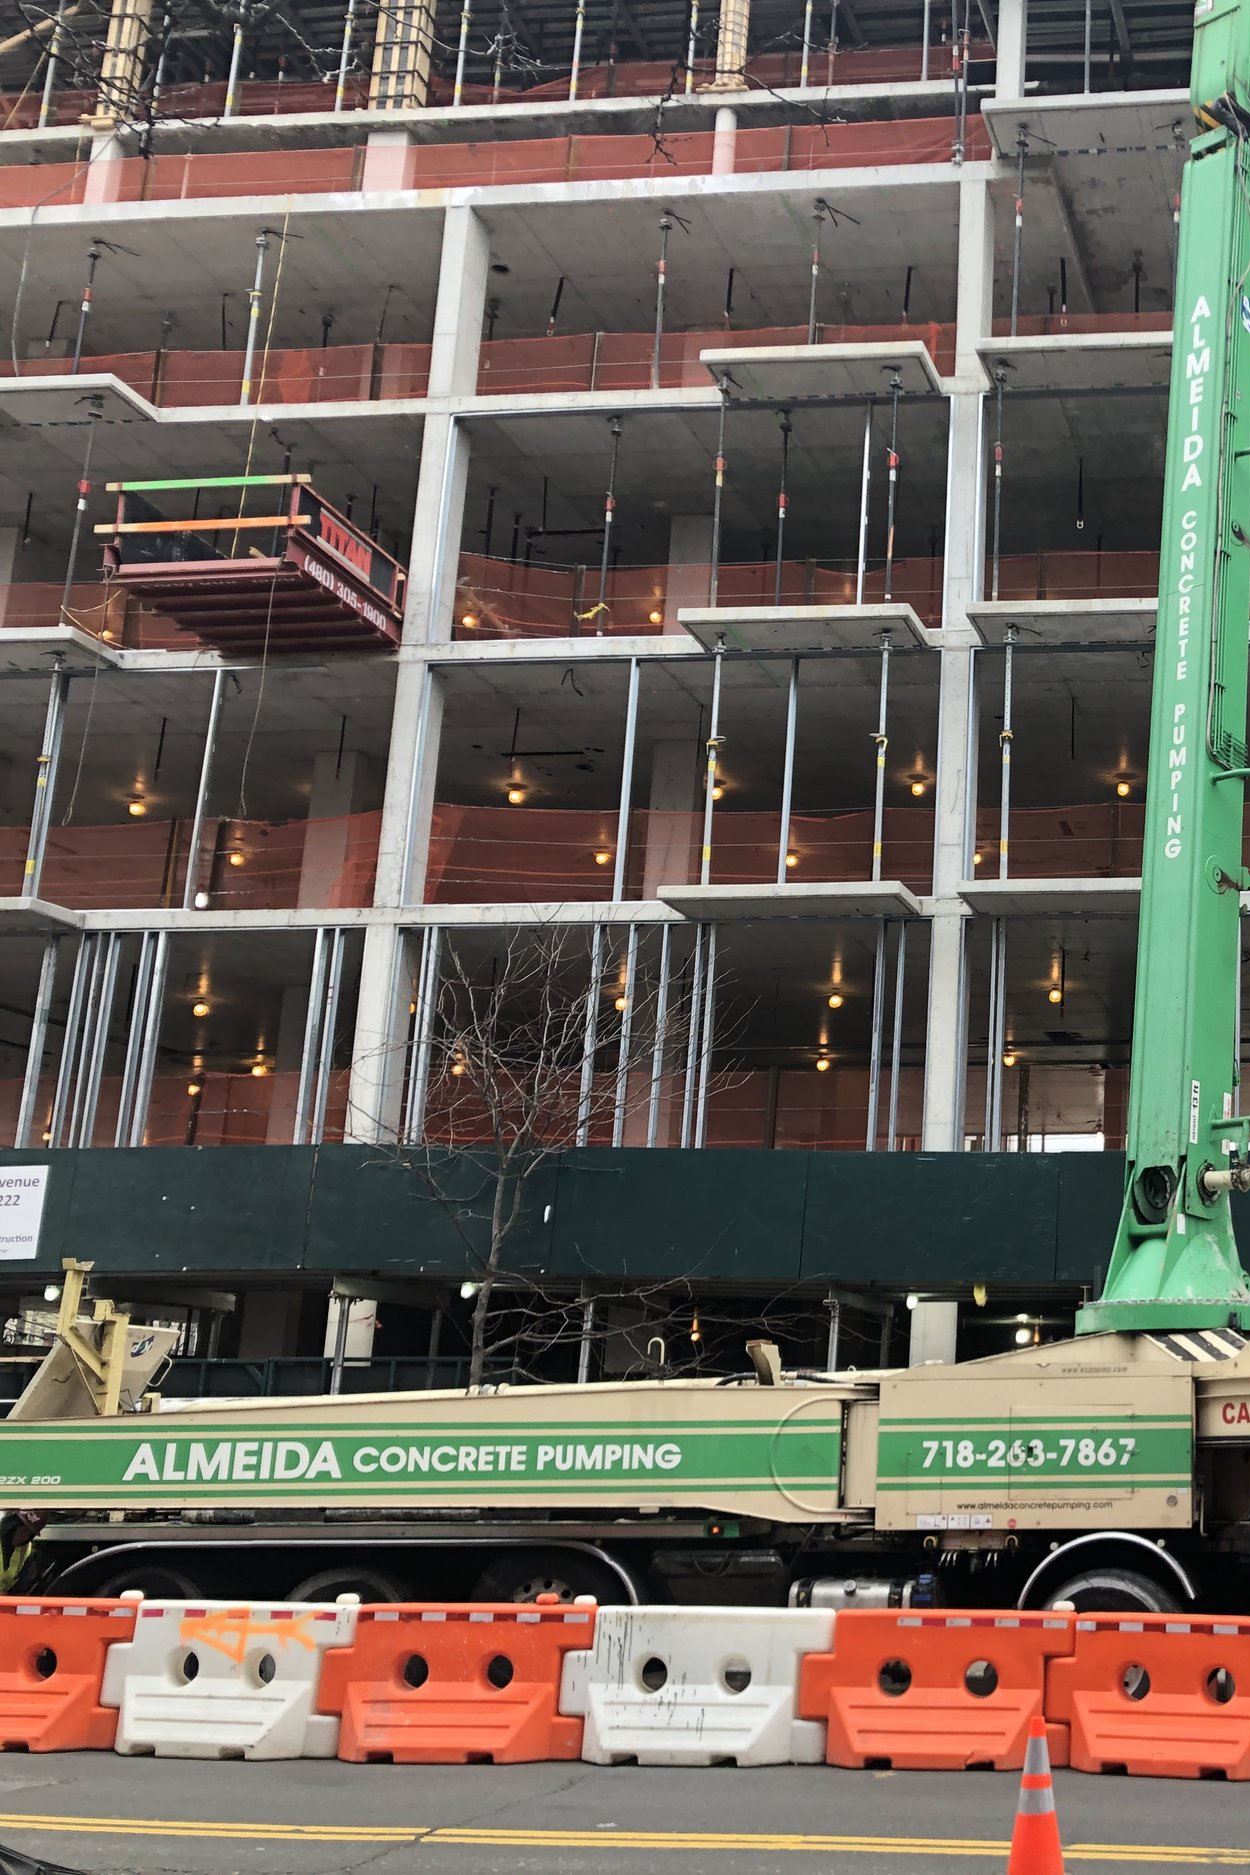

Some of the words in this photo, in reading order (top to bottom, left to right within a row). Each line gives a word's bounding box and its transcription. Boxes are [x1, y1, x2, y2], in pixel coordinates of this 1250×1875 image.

[1181, 295, 1211, 493] ALMEIDA
[319, 509, 372, 579] TITAN
[304, 554, 335, 591] (480)
[1176, 510, 1198, 681] CONCRETE
[1164, 703, 1187, 859] PUMPING
[122, 1441, 342, 1481] ALMEIDA
[353, 1445, 527, 1473] CONCRETE
[536, 1443, 682, 1470] PUMPING
[922, 1438, 1136, 1468] 718-263-7867
[31, 1475, 62, 1485] 200
[957, 1501, 1113, 1511] www.almeidaconcretepumping.com
